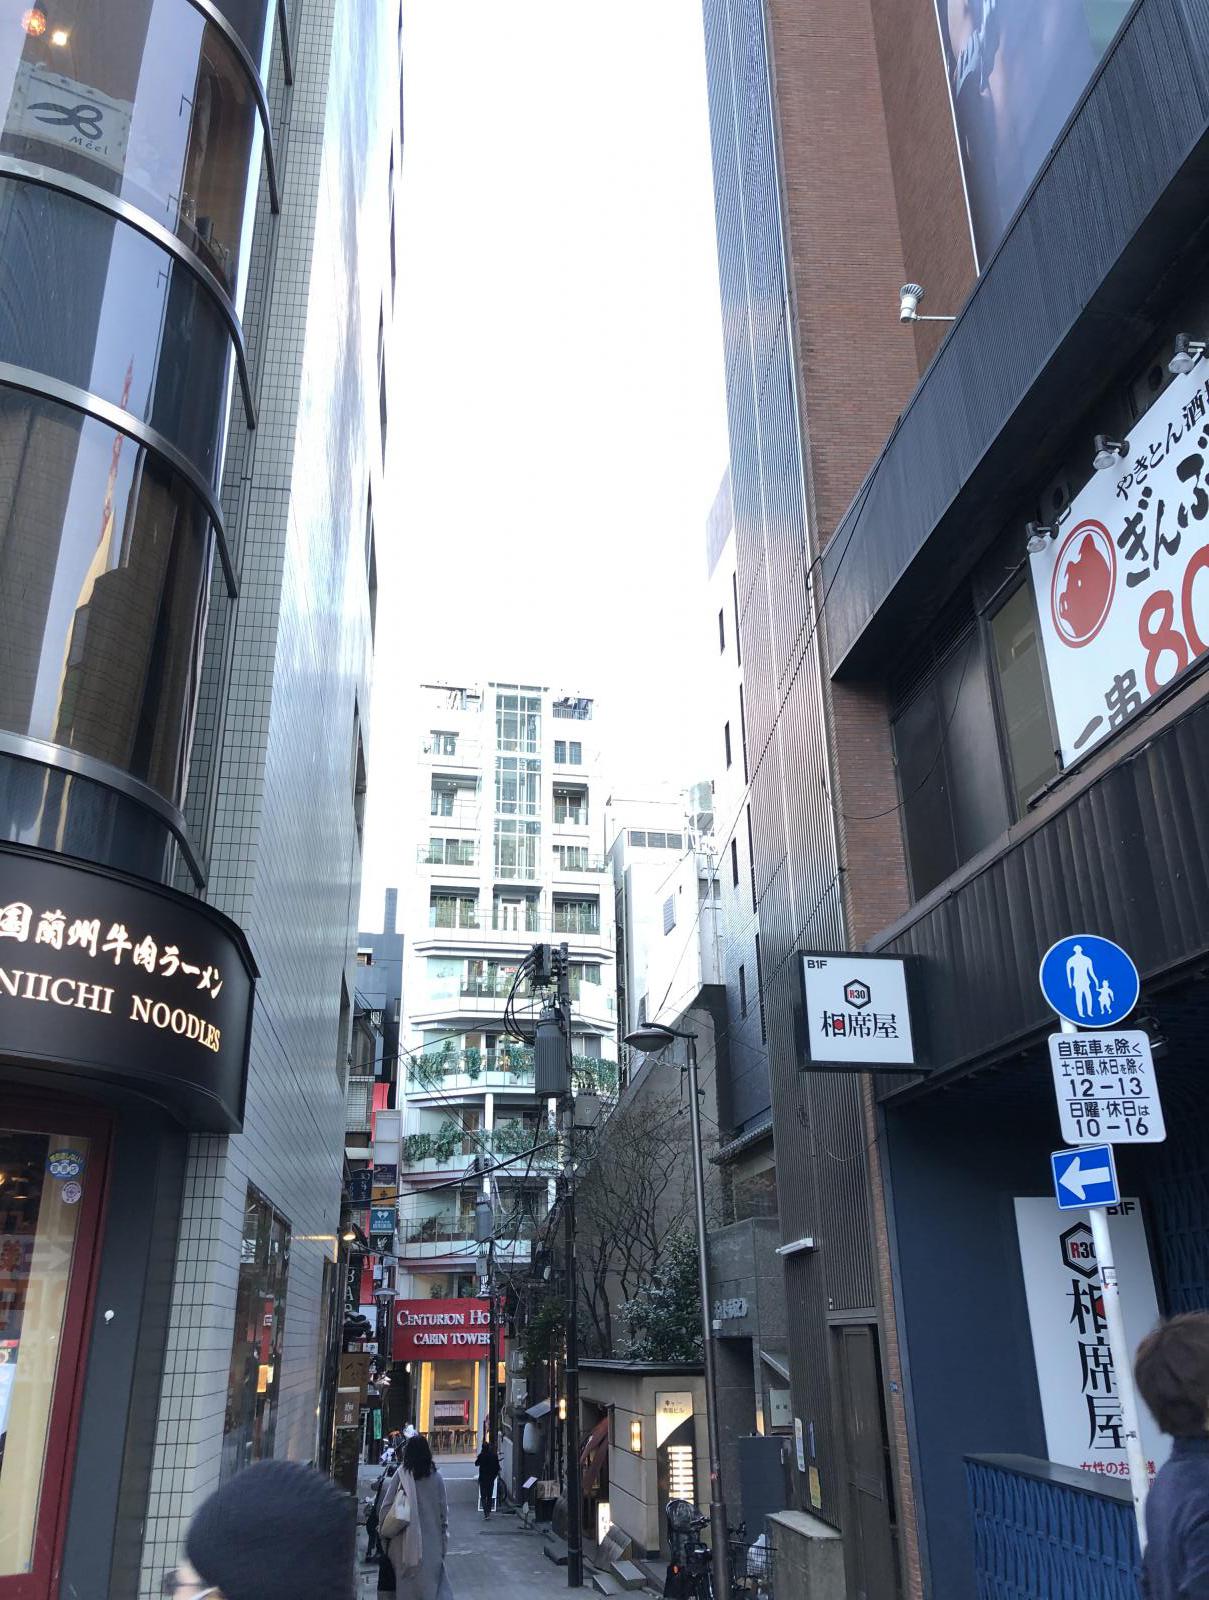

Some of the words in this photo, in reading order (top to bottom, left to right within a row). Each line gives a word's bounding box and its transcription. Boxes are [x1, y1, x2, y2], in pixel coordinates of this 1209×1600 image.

[1116, 380, 1209, 500] やきとん酒
[807, 960, 827, 969] B1F
[129, 994, 221, 1053] NOODLES
[820, 1010, 900, 1039] 相席屋
[1058, 1038, 1142, 1057] 自転車を除く
[413, 1333, 448, 1345] CABIN
